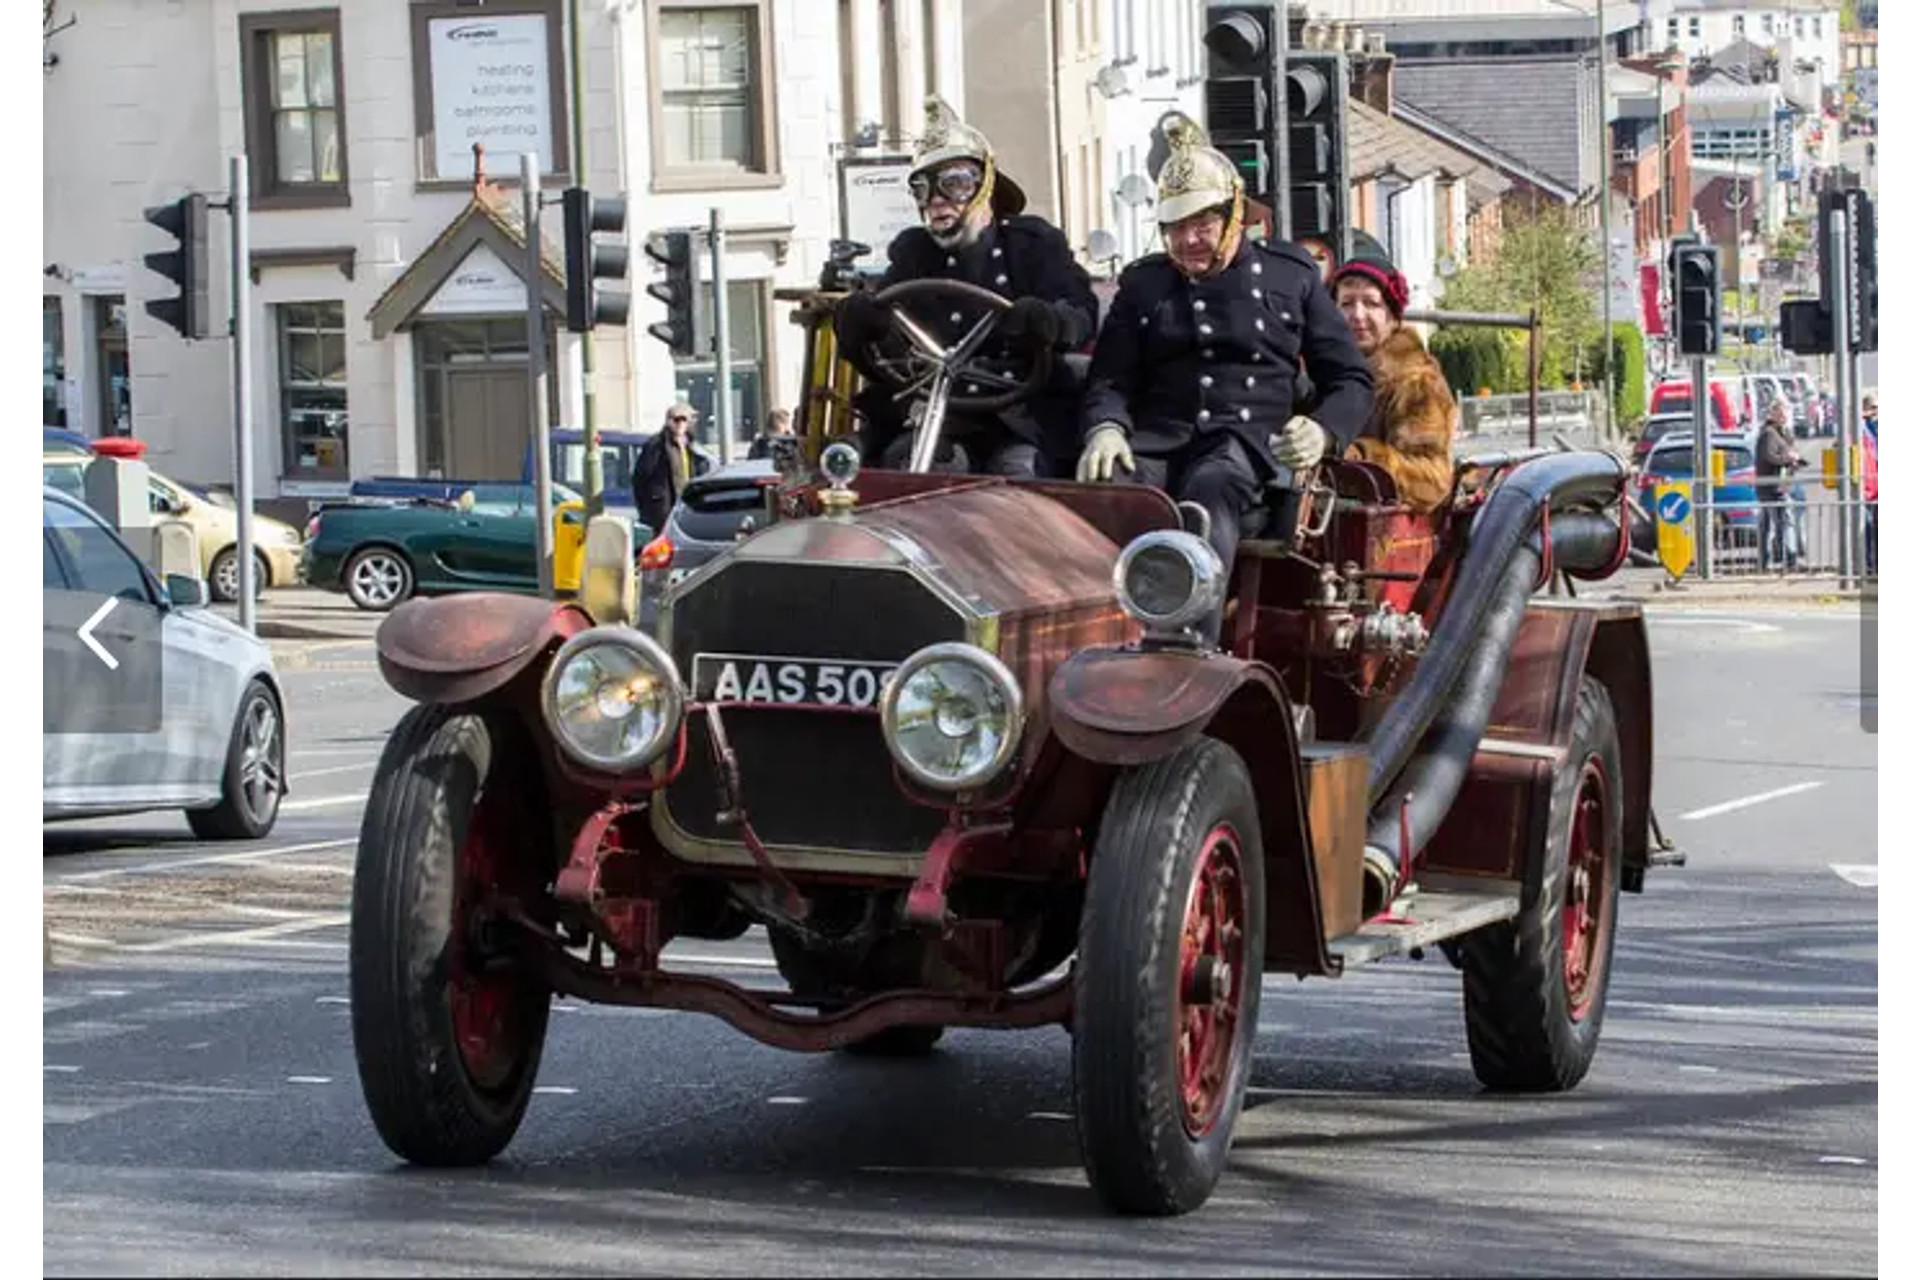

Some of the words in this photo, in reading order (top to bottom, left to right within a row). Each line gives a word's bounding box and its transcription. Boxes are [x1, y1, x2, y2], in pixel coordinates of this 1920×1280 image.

[477, 63, 534, 77] heating
[471, 83, 535, 97] kitchens
[454, 104, 536, 118] bathrooms
[466, 123, 538, 138] plumbing
[714, 661, 806, 703] AAS
